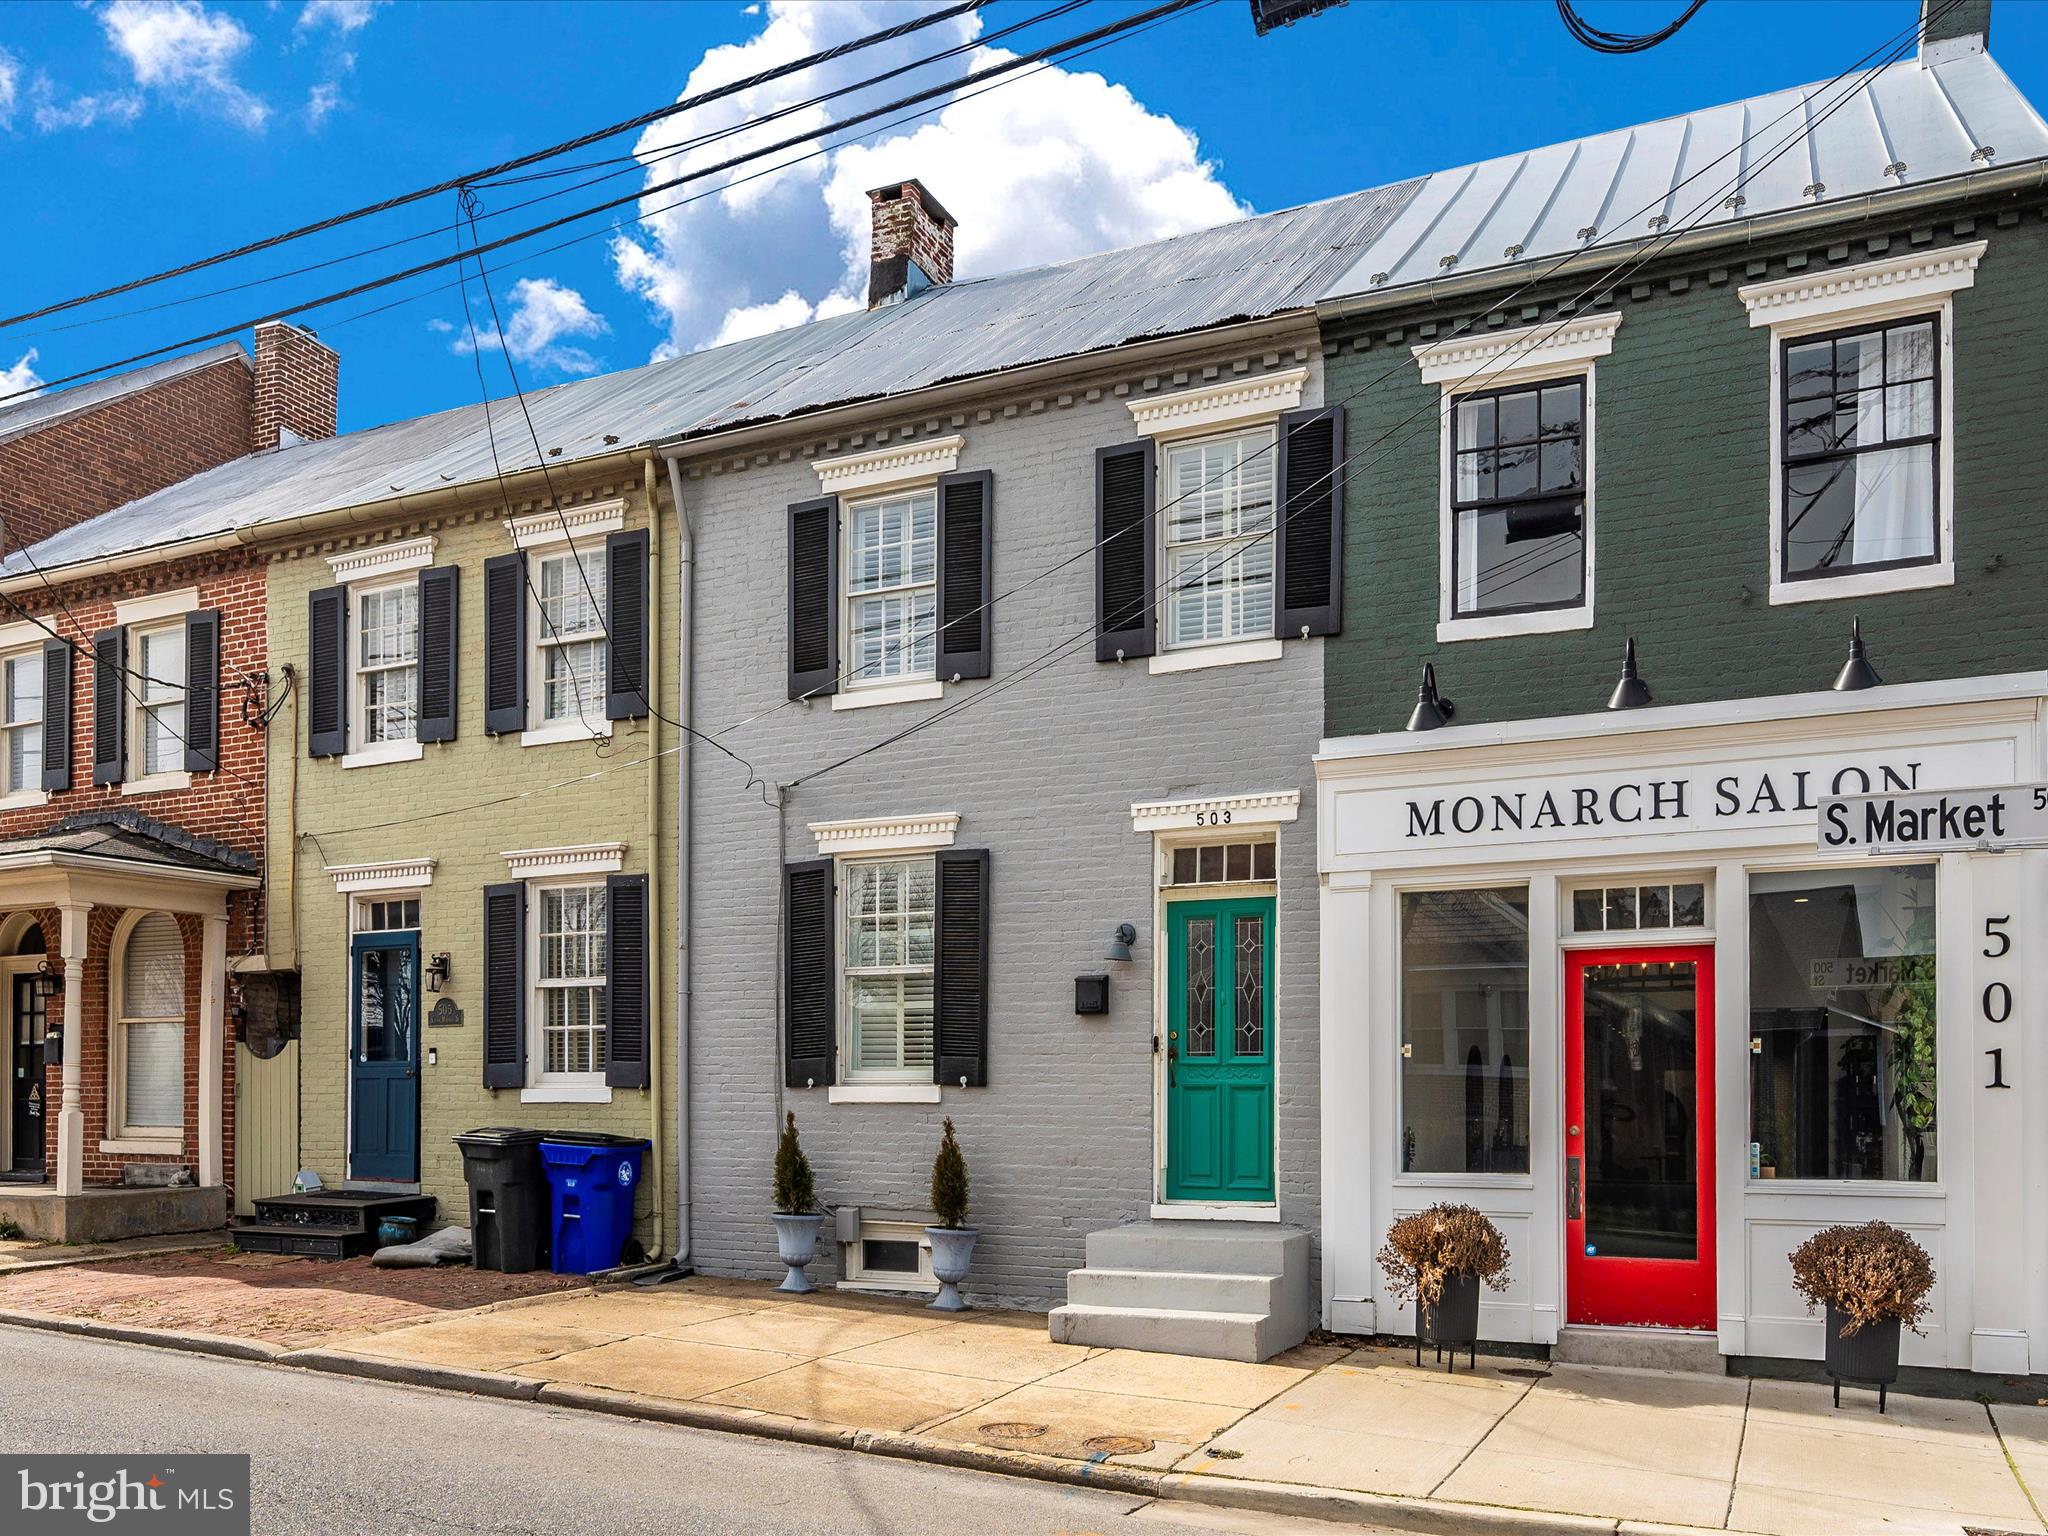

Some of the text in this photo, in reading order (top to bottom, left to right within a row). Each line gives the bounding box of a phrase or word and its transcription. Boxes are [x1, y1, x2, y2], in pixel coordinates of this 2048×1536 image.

[1196, 810, 1231, 826] 503
[1405, 763, 1922, 837] MONARCH SALON
[1824, 793, 2005, 846] S. Market
[2033, 787, 2048, 811] 5
[1982, 914, 2012, 1089] 501
